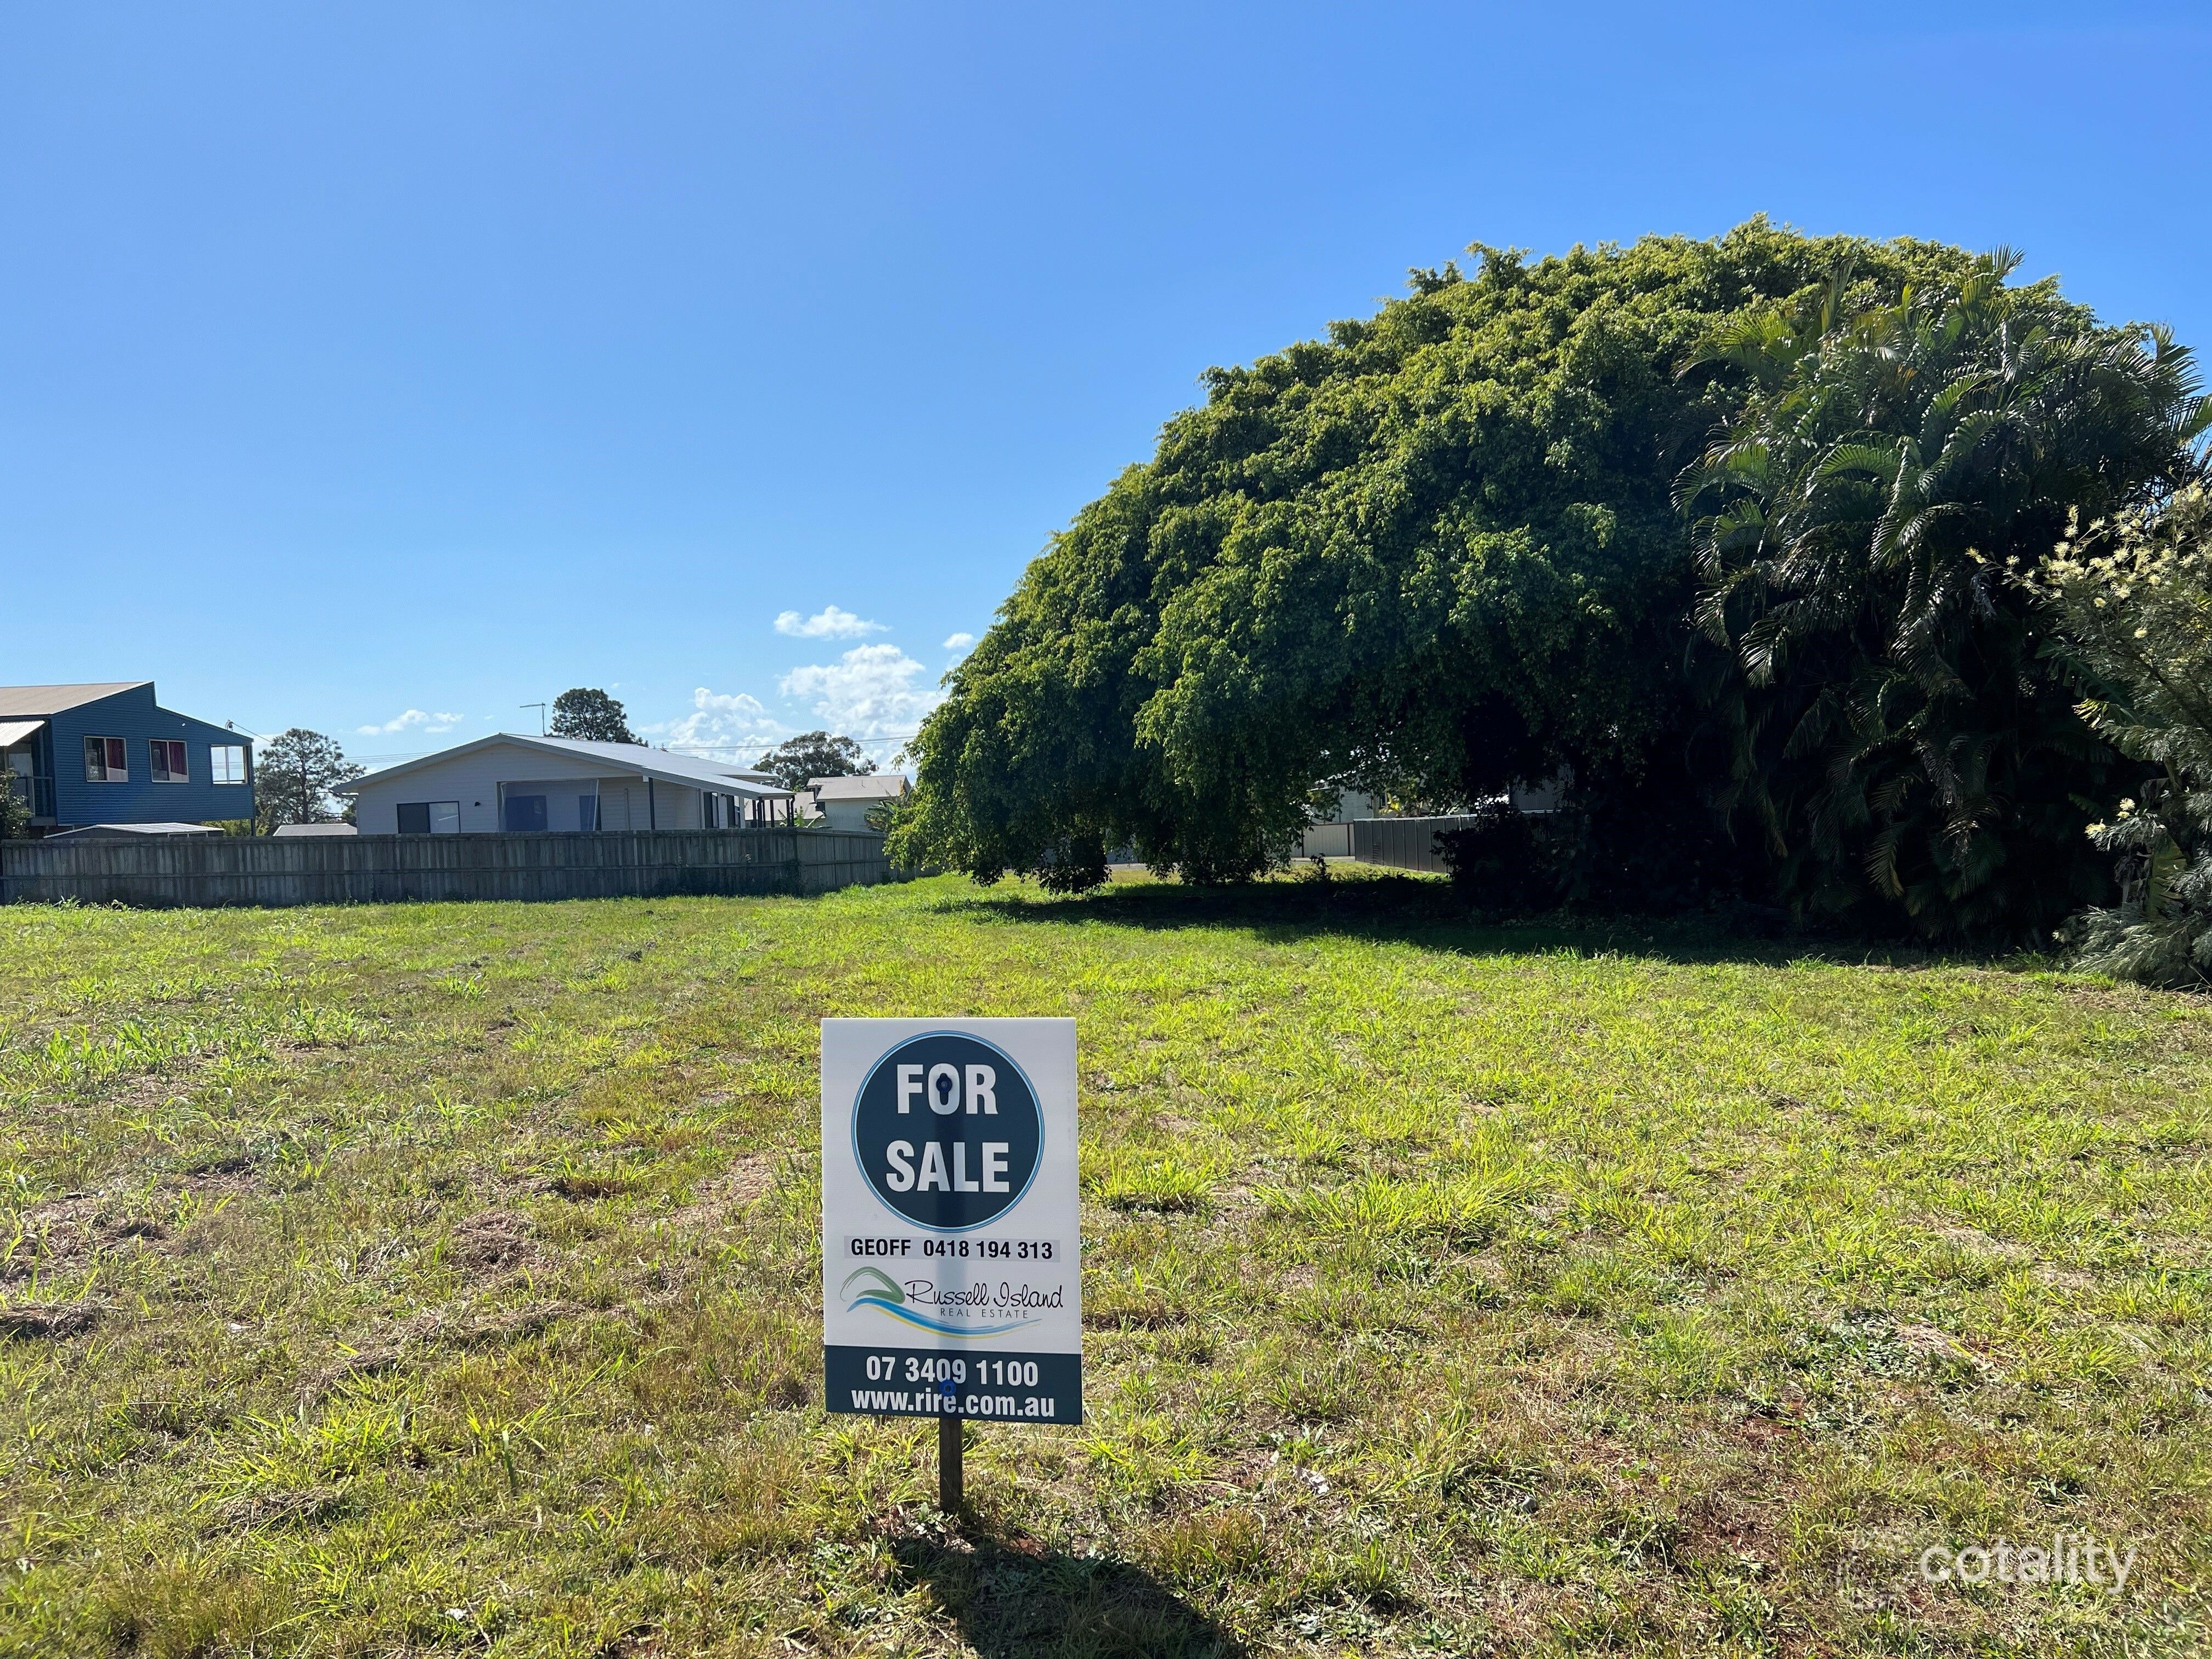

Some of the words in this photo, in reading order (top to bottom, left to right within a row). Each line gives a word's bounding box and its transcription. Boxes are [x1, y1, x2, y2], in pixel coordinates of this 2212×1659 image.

[897, 1063, 998, 1115] FOR
[886, 1140, 1009, 1193] SALE
[851, 1238, 911, 1256] GEOFF
[923, 1240, 969, 1257] 0418
[977, 1241, 1011, 1259] 194
[1017, 1242, 1053, 1259] 313
[904, 1280, 990, 1306] Russell
[994, 1282, 1064, 1308] Island
[940, 1307, 970, 1317] REAL
[981, 1309, 1028, 1319] ESTATE
[866, 1356, 896, 1381] 07
[905, 1358, 966, 1384] 3409
[976, 1361, 1039, 1386] 1100
[851, 1387, 1054, 1417] www.rire.com.au
